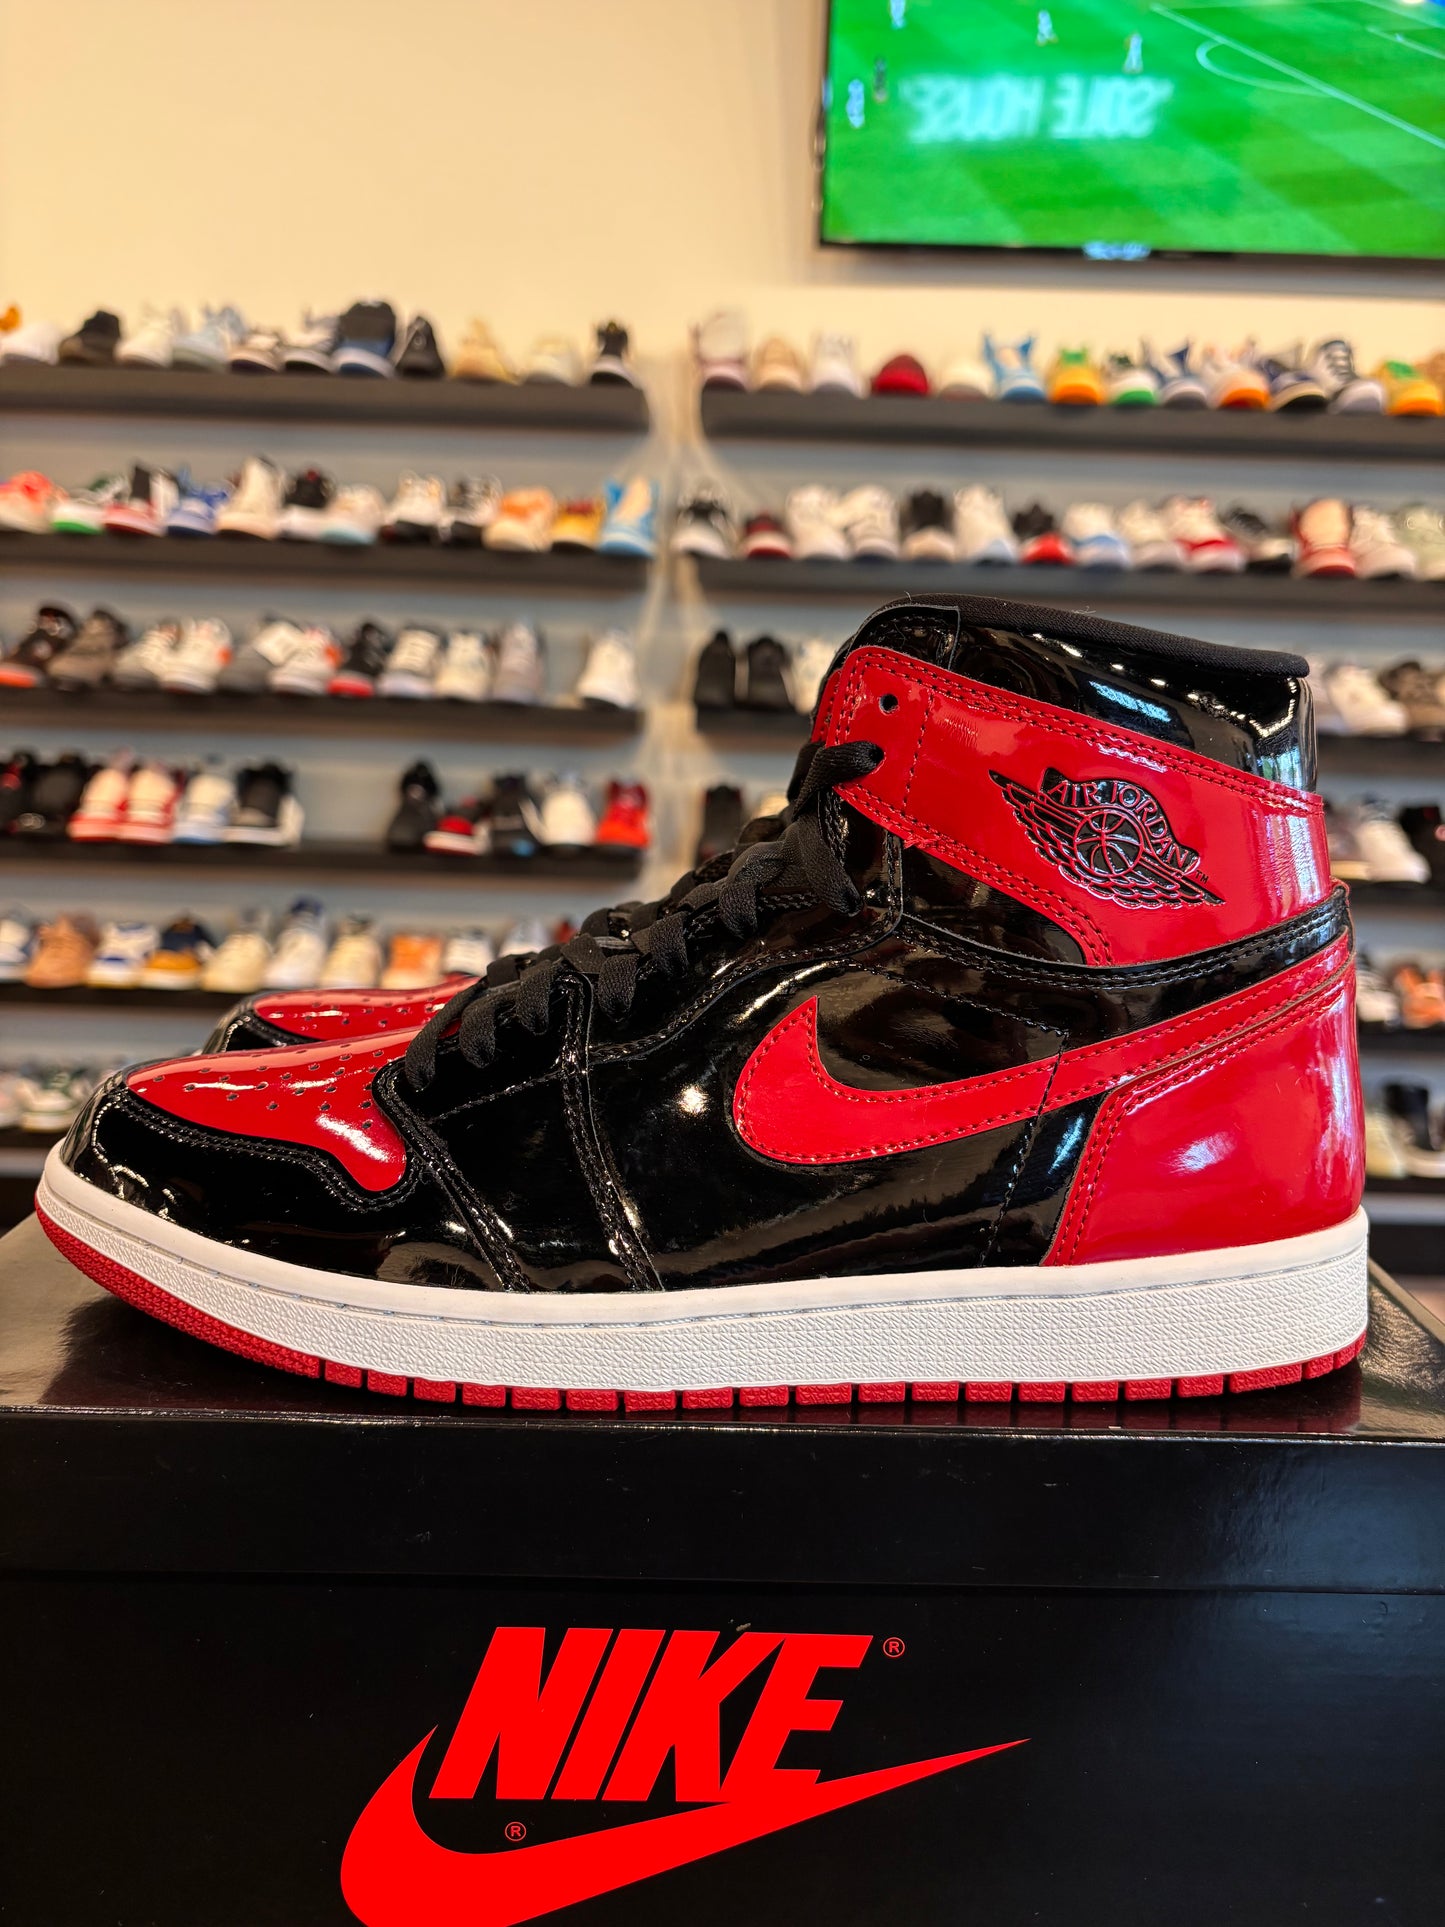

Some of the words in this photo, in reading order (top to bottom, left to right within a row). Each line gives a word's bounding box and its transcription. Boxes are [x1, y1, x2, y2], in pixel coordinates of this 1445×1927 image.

[1047, 779, 1100, 806] AIR
[1111, 780, 1189, 869] JORDAN
[428, 1627, 874, 1803] NIKE
